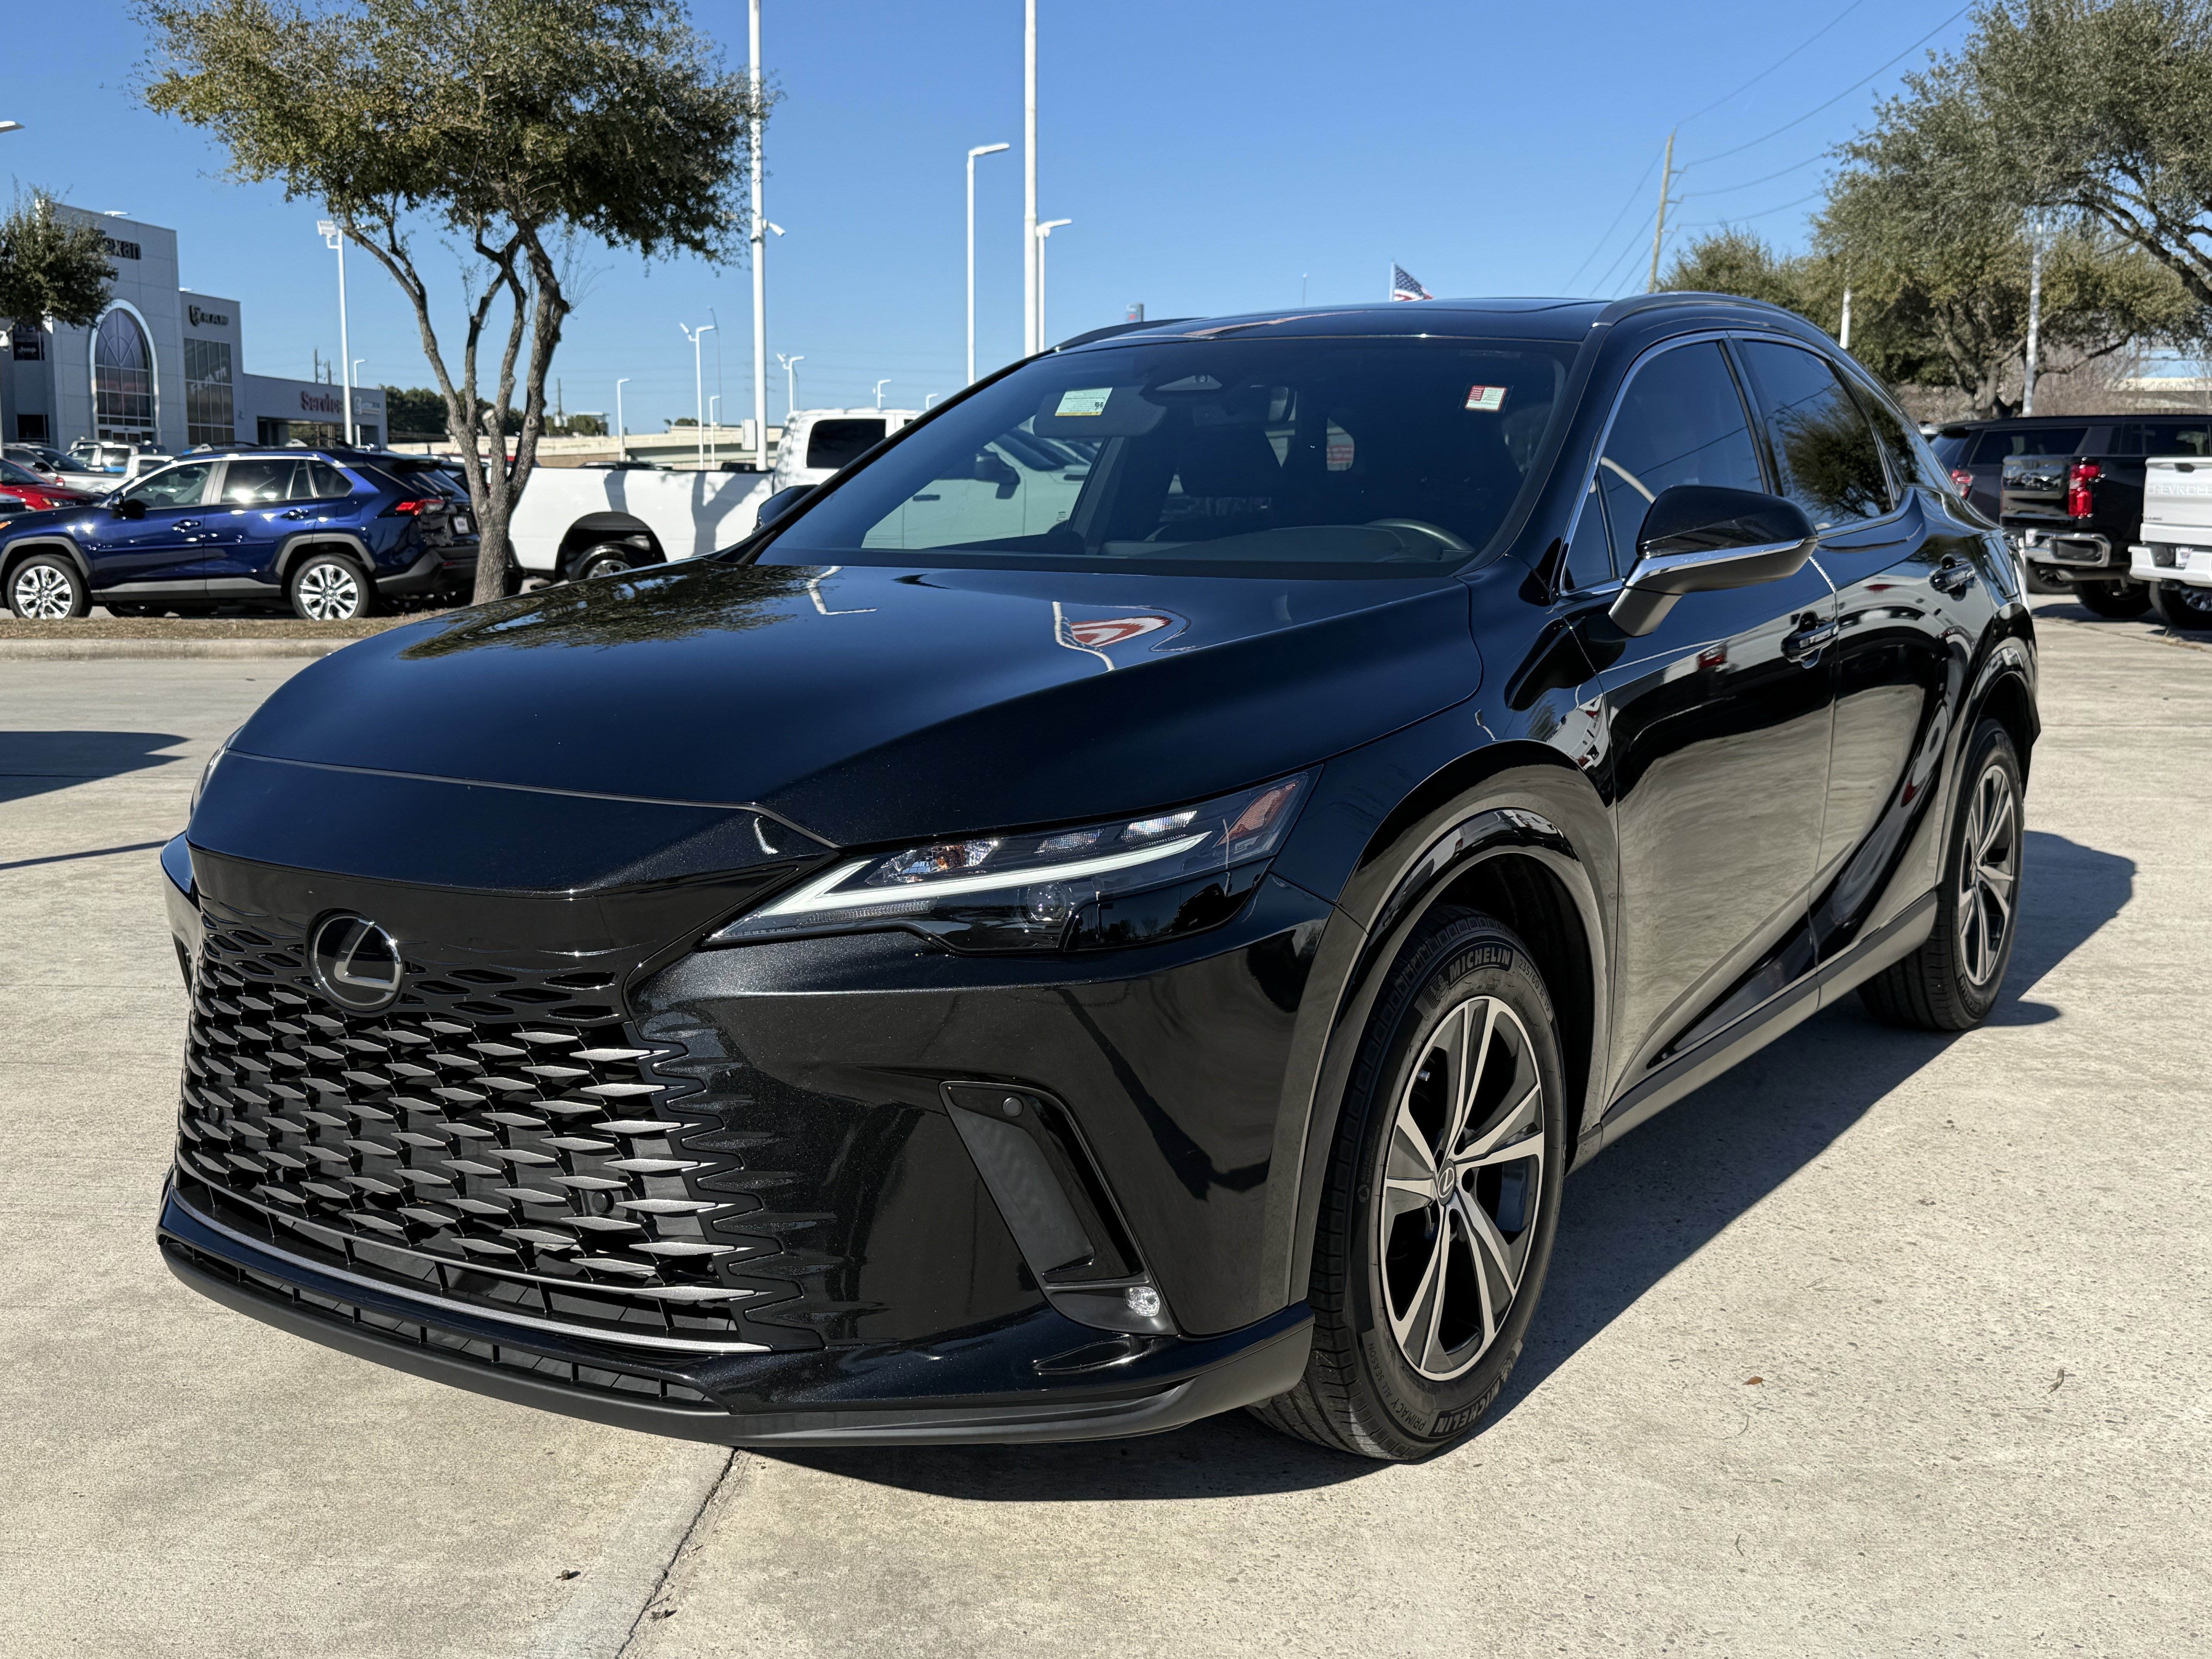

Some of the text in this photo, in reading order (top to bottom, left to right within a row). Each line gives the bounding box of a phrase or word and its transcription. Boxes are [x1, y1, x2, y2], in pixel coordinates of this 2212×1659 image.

[1449, 947, 1510, 983] MICHELIN
[1518, 959, 1539, 989] 235/60
[1540, 988, 1544, 999] R
[1368, 1342, 1385, 1381] SEASON
[1379, 1380, 1393, 1398] ALL
[1435, 1379, 1500, 1433] MICHELIN
[1391, 1398, 1427, 1431] PRIMACY
